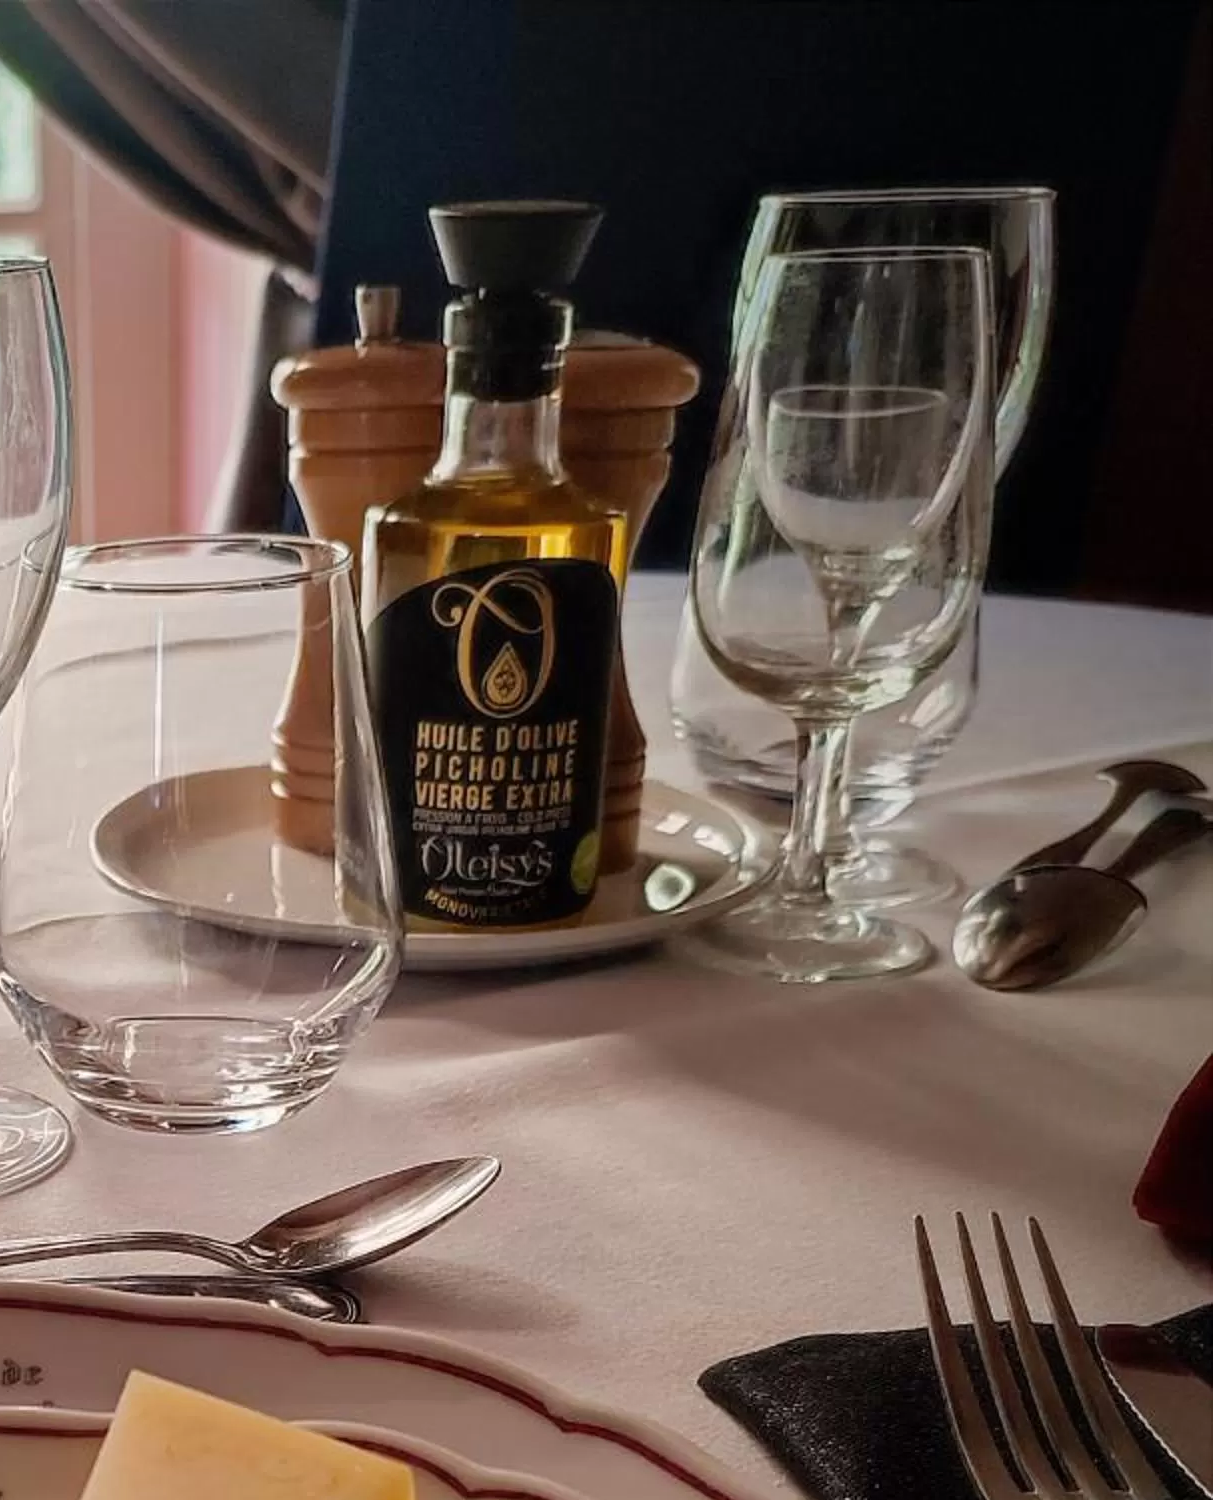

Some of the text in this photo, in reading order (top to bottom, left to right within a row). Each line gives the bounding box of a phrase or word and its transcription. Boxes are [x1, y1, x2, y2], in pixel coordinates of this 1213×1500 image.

[416, 719, 579, 752] HUILE D'OLIVE
[415, 749, 575, 782] PICHOLINE
[415, 779, 573, 811] VIERGE EXTRA
[0, 1357, 44, 1387] de
